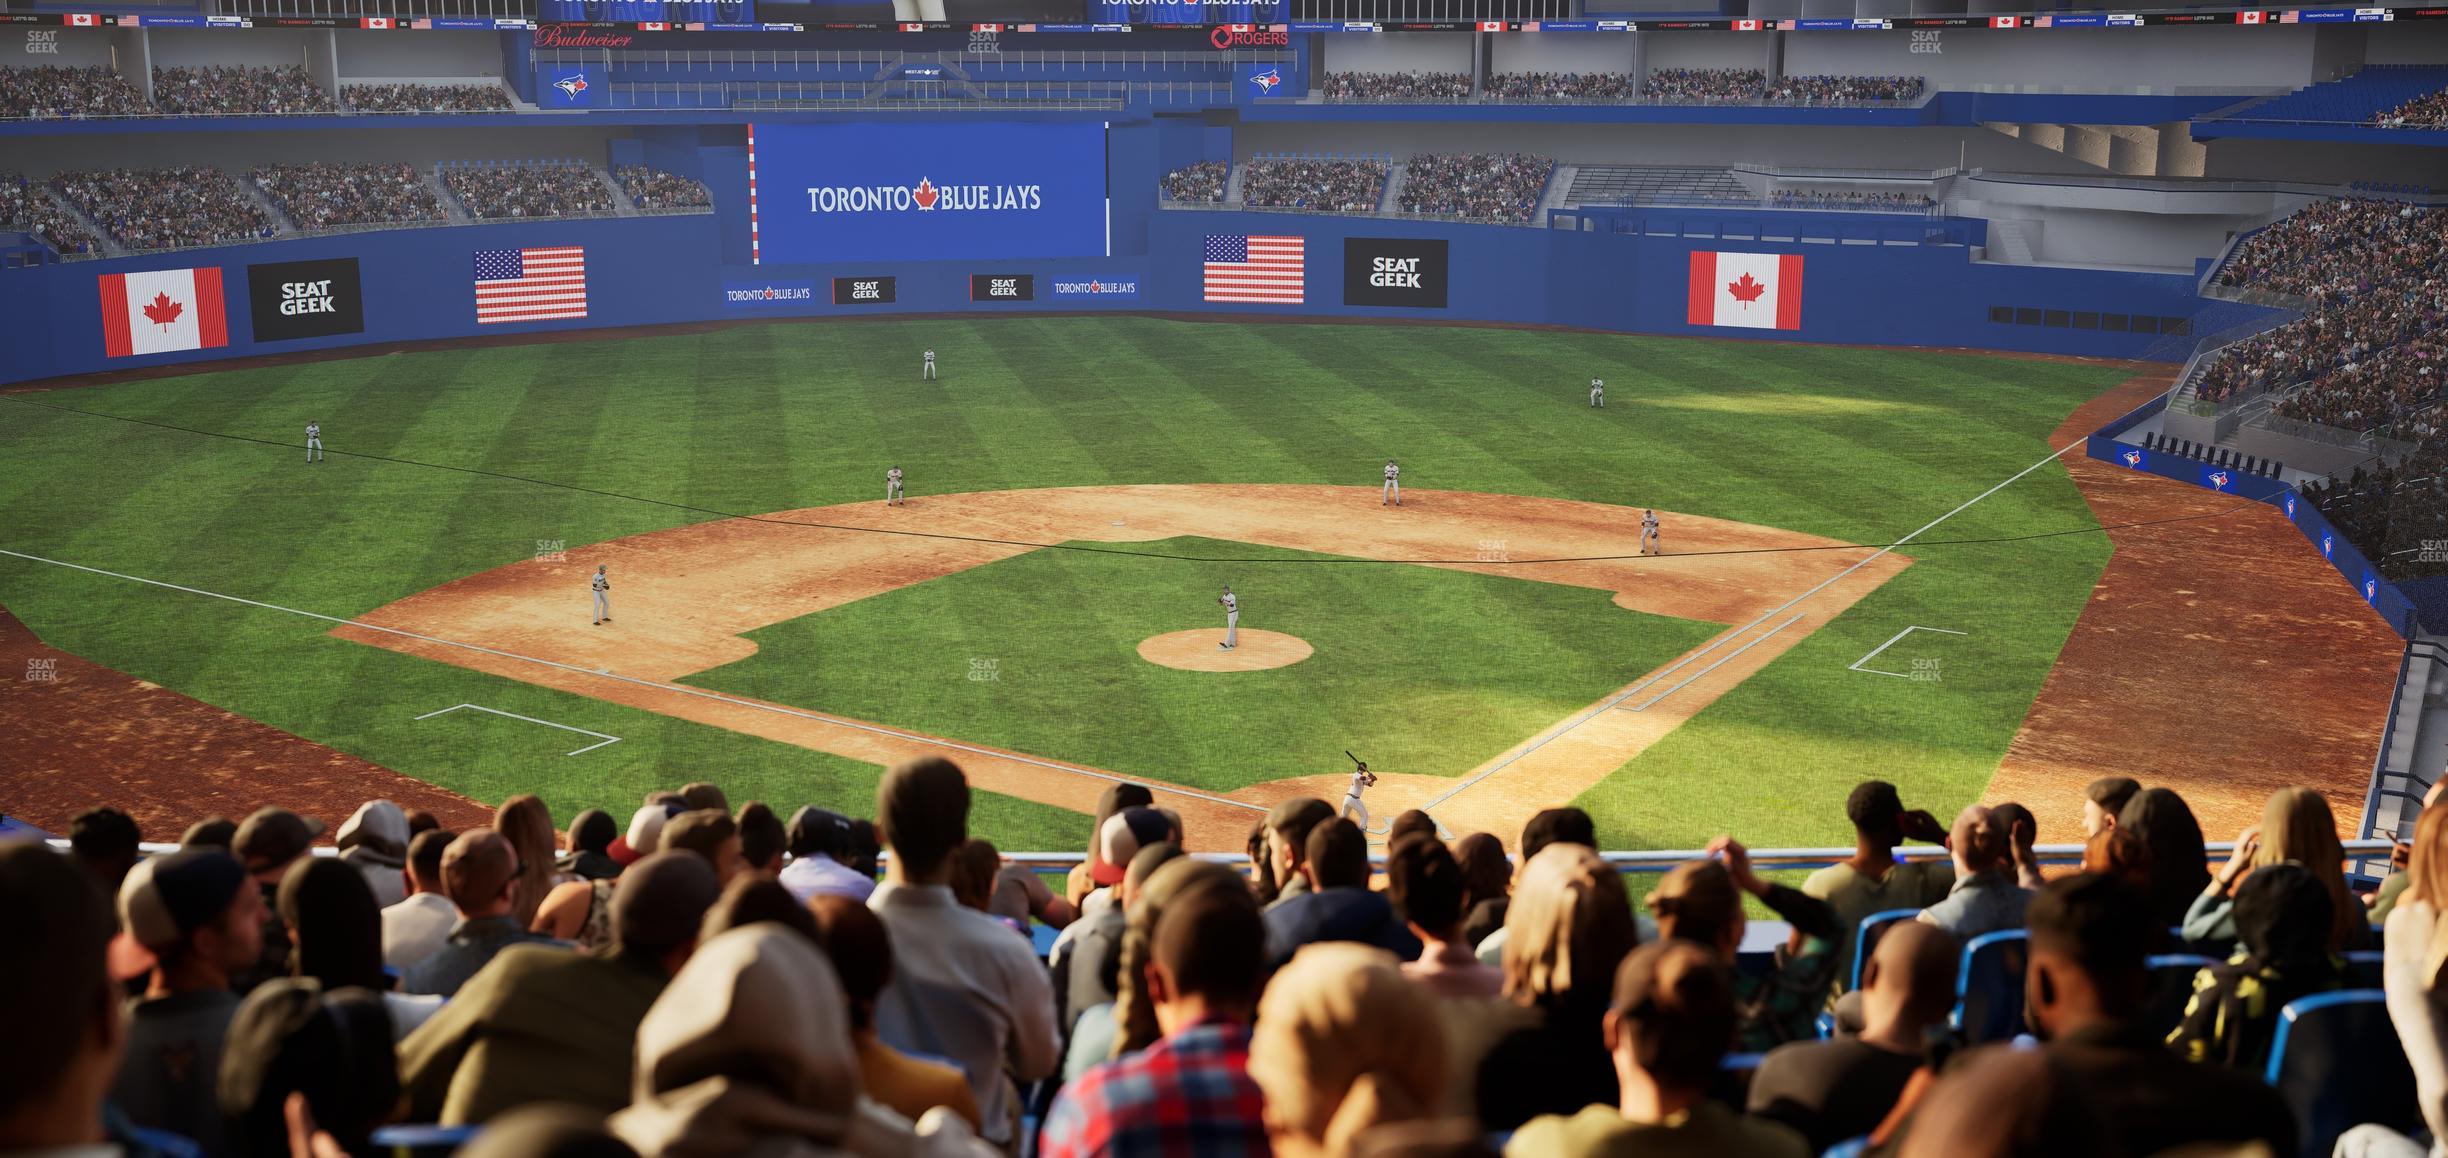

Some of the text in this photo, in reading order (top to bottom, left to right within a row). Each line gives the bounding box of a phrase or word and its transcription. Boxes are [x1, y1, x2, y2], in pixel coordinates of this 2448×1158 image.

[534, 22, 633, 47] Budweiser
[1234, 32, 1288, 45] ROGERS
[807, 184, 1042, 213] TORONTO BLUE JAYS
[1373, 256, 1420, 273] SEAT
[853, 281, 879, 291] SEAT
[991, 278, 1016, 288] SEAT
[1369, 272, 1422, 289] GEEK
[281, 279, 332, 299] SEAT
[727, 287, 810, 301] TORONTO BLUE JAYS
[852, 289, 880, 299] GEEK
[989, 287, 1017, 296] GEEK
[1055, 282, 1135, 294] TORONTO BLUE JAYS
[280, 296, 336, 316] GEEK
